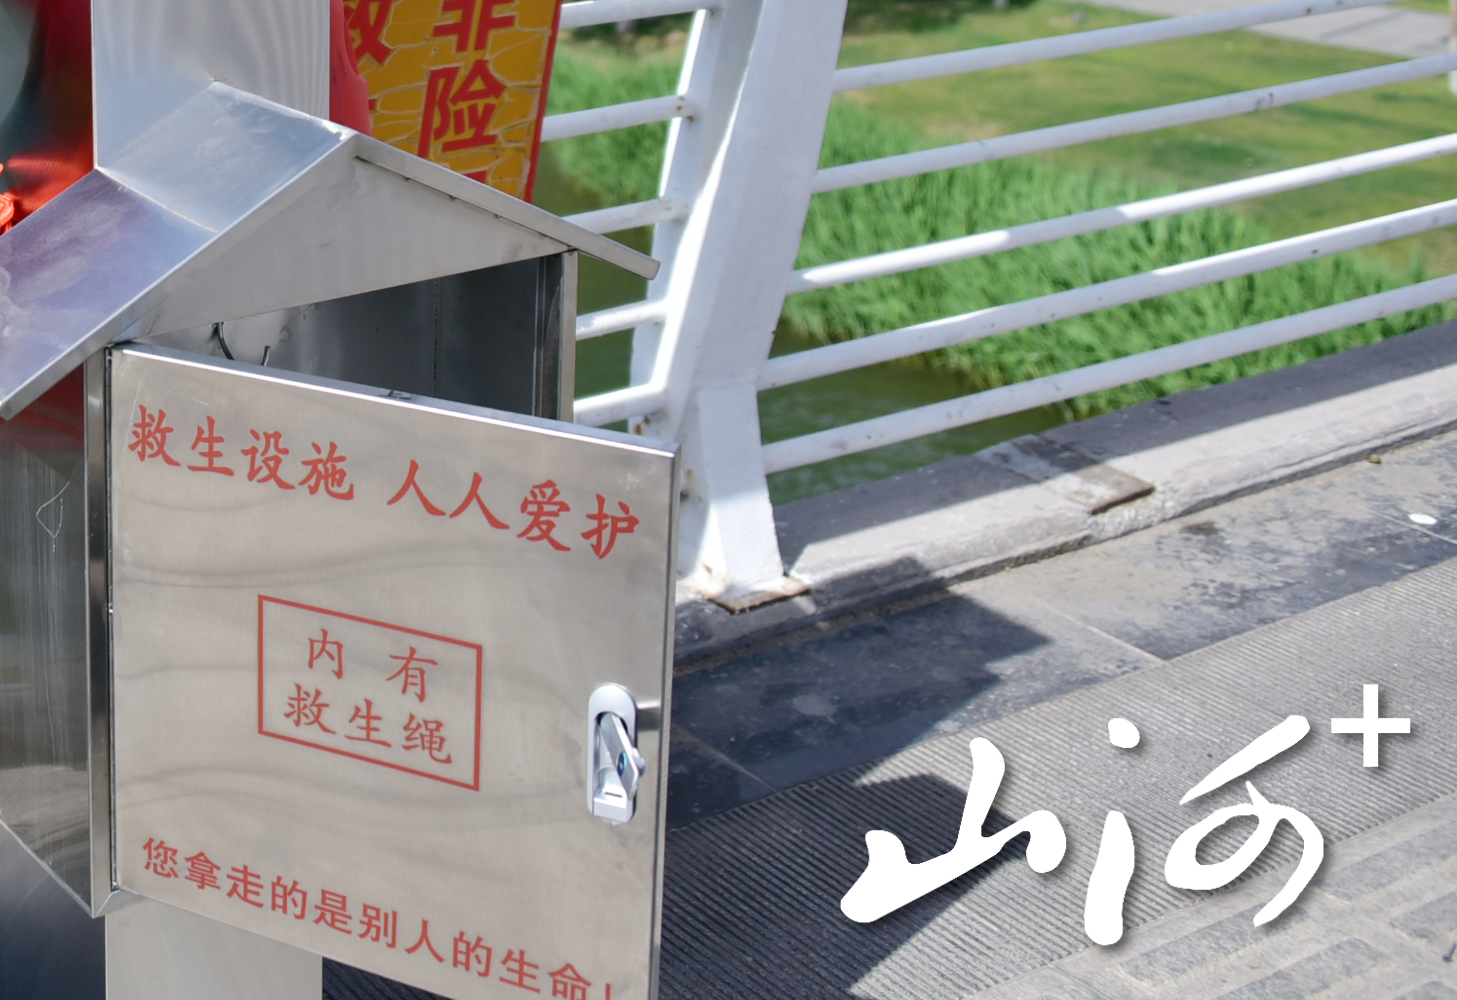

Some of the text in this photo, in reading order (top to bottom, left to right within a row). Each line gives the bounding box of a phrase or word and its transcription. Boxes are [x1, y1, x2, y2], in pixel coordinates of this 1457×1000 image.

[128, 404, 641, 560] 救生设施 人人爱护
[283, 683, 453, 765] 救生绳
